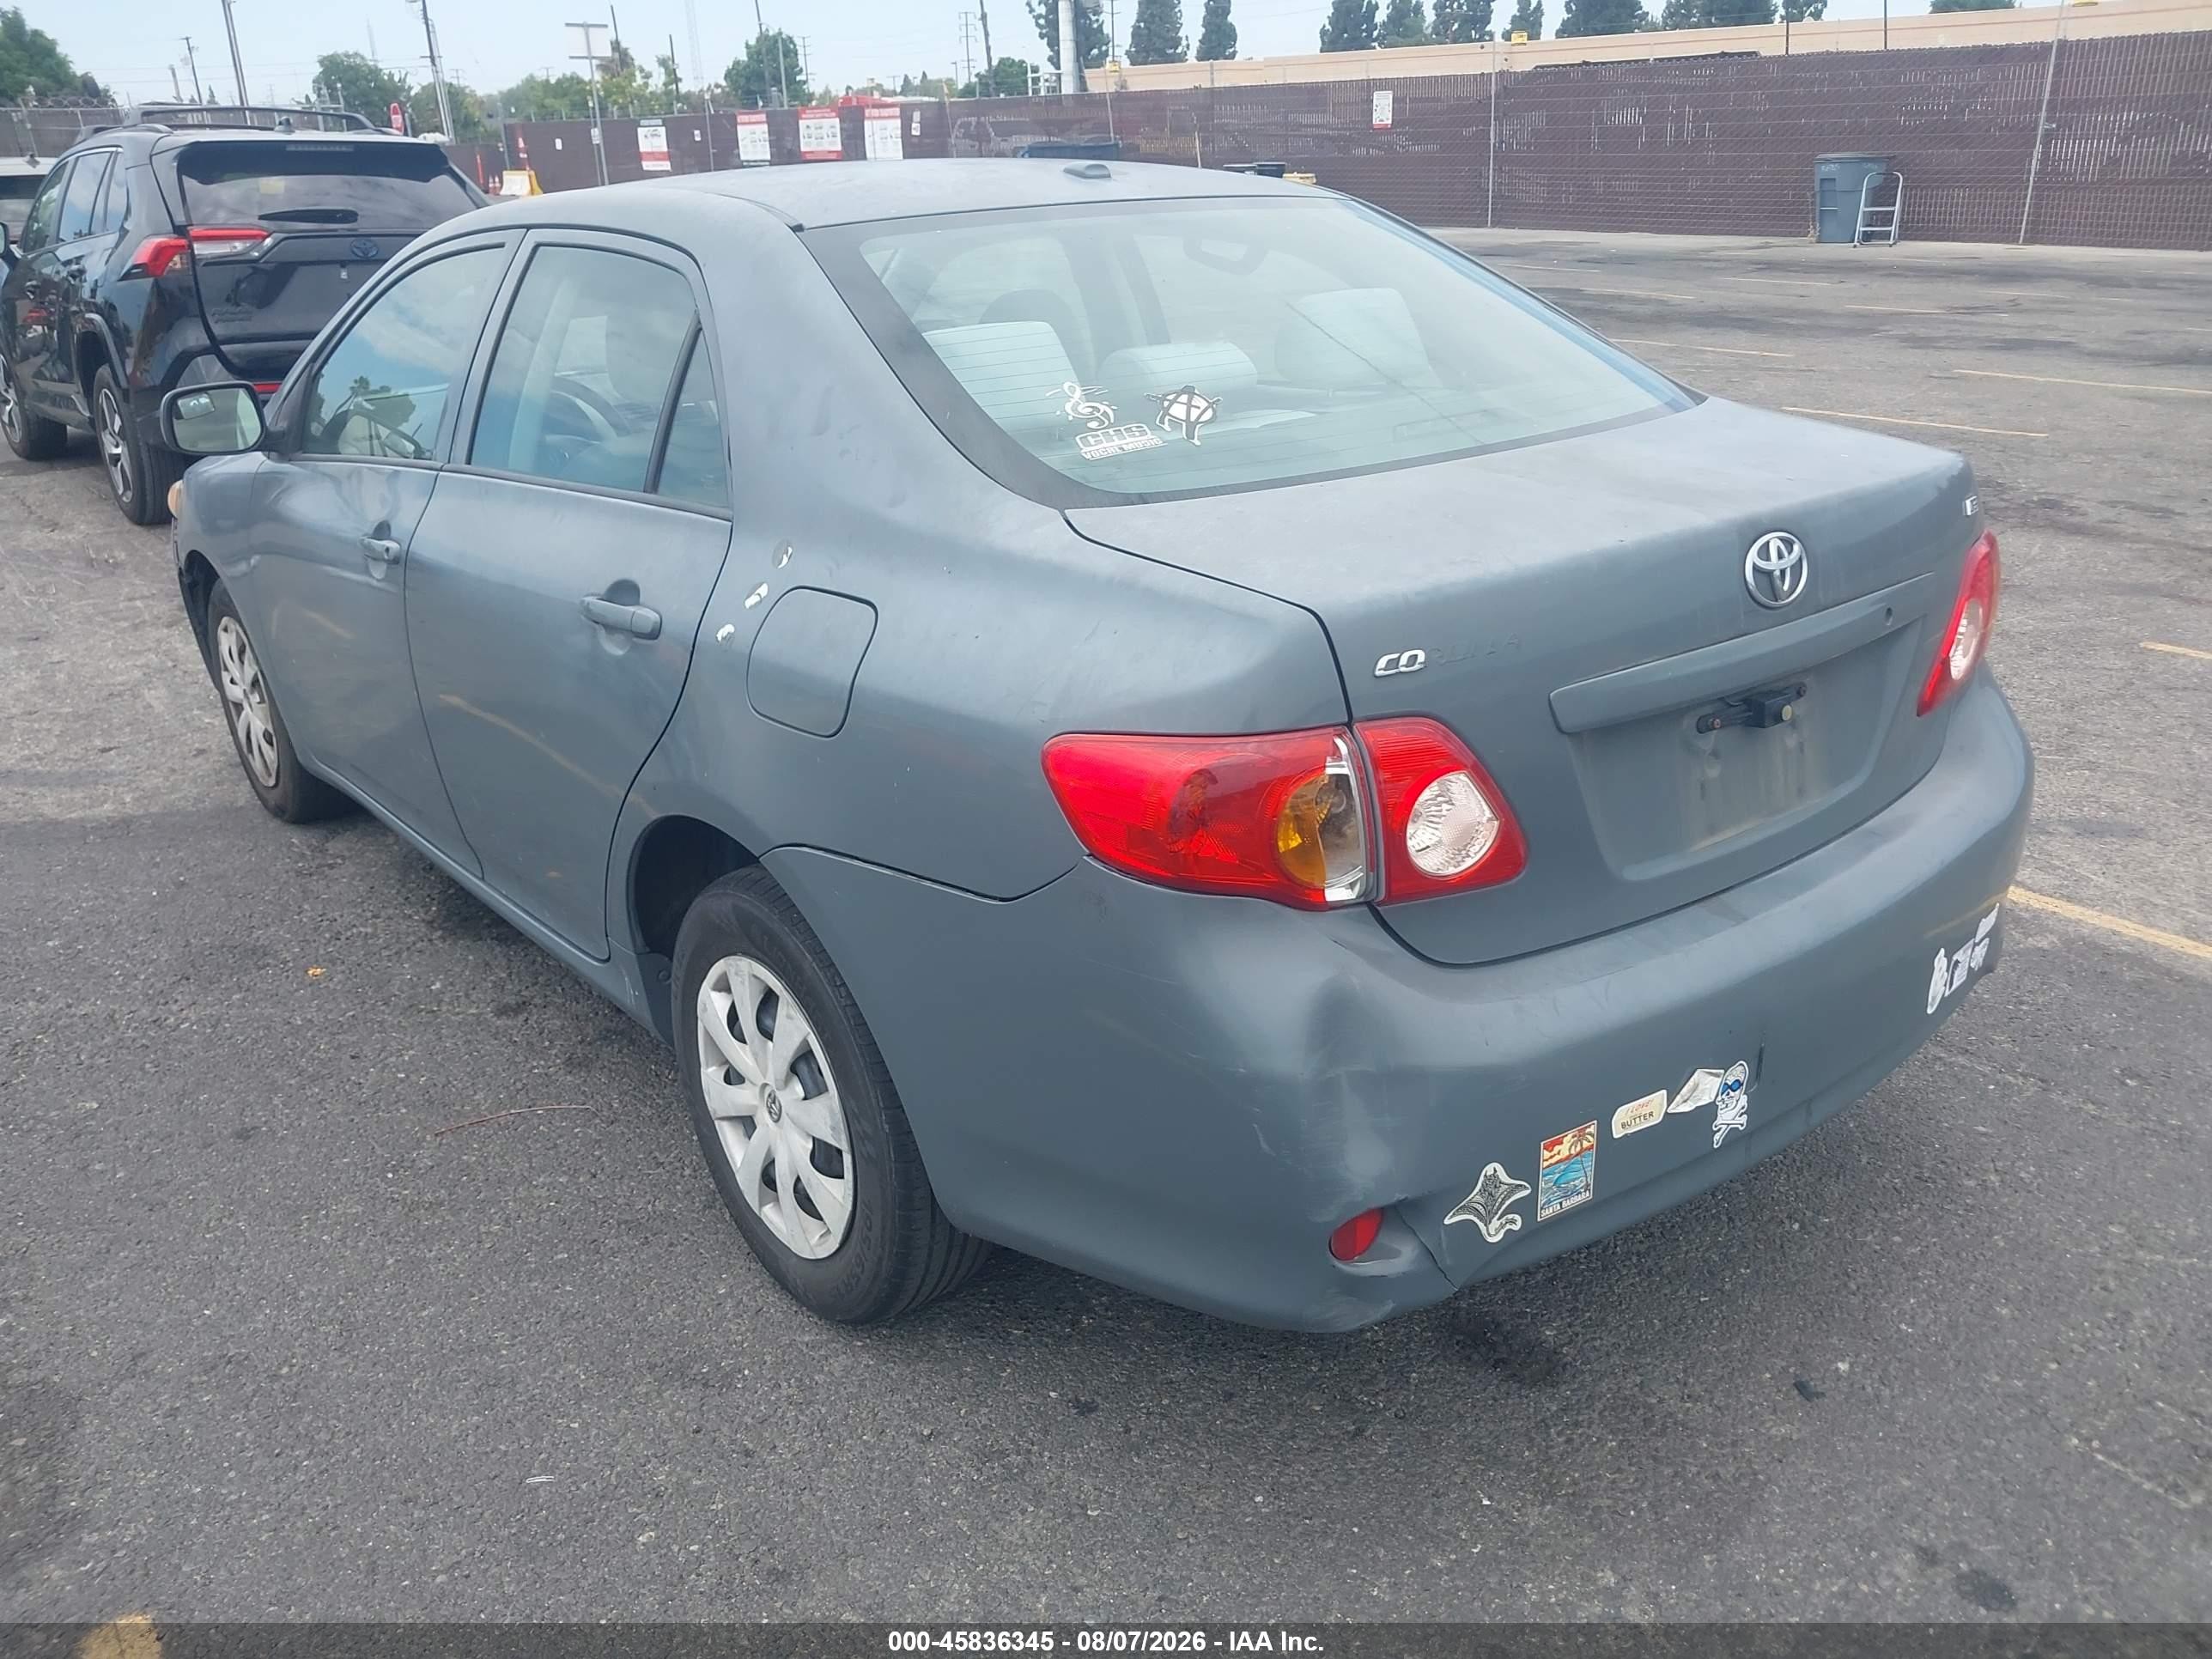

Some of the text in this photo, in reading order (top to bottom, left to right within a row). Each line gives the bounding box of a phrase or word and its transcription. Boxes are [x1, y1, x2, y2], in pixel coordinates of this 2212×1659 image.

[1081, 425, 1150, 447] CHS
[1084, 446, 1121, 459] VOCAL
[1620, 1111, 1655, 1129] BUTTER
[1540, 1190, 1590, 1217] SANTA BARBARA
